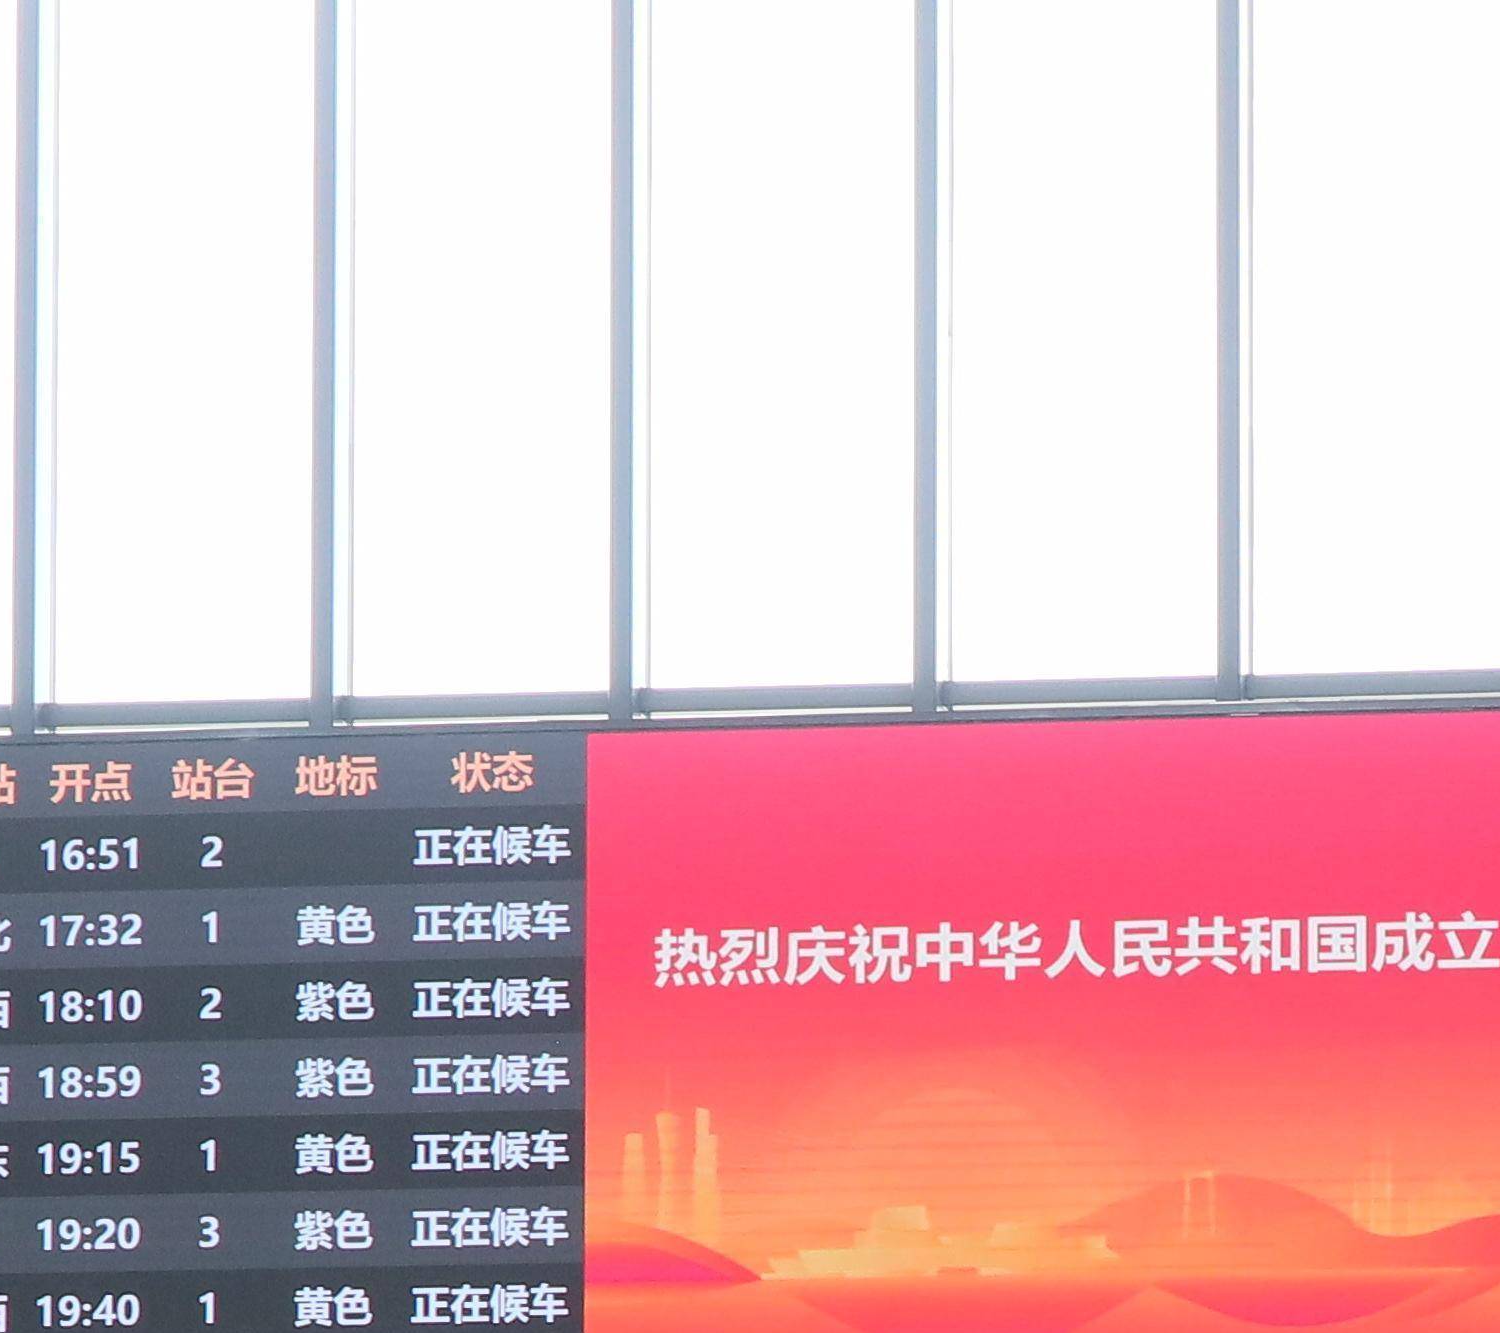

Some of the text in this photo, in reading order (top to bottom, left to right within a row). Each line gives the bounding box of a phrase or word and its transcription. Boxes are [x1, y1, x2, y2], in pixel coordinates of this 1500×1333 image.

[50, 761, 132, 803] 开点
[172, 758, 254, 800] 站台
[295, 755, 377, 796] 地标
[451, 751, 533, 793] 状态
[42, 838, 137, 870] 16:51
[202, 837, 222, 867] 2
[414, 825, 571, 866] 正在候车
[41, 914, 141, 946] 17:32
[203, 912, 217, 942] 1
[297, 905, 374, 945] 黄色
[413, 901, 570, 942] 正在候车
[40, 990, 141, 1022] 18:10
[201, 988, 221, 1018] 2
[297, 982, 374, 1021] 紫色
[413, 977, 570, 1018] 正在候车
[39, 1066, 140, 1098] 18:59
[201, 1065, 220, 1095] 3
[296, 1058, 373, 1097] 紫色
[413, 1054, 569, 1094] 正在候车
[39, 1142, 139, 1174] 19:15
[201, 1140, 215, 1170] 1
[296, 1134, 373, 1174] 黄色
[412, 1130, 569, 1171] 正在候车
[38, 1218, 140, 1250] 19:20
[200, 1217, 219, 1247] 3
[295, 1211, 372, 1250] 紫色
[412, 1207, 568, 1247] 正在候车
[38, 1295, 139, 1326] 19:40
[200, 1293, 214, 1323] 1
[295, 1287, 372, 1326] 黄色
[411, 1283, 568, 1324] 正在候车
